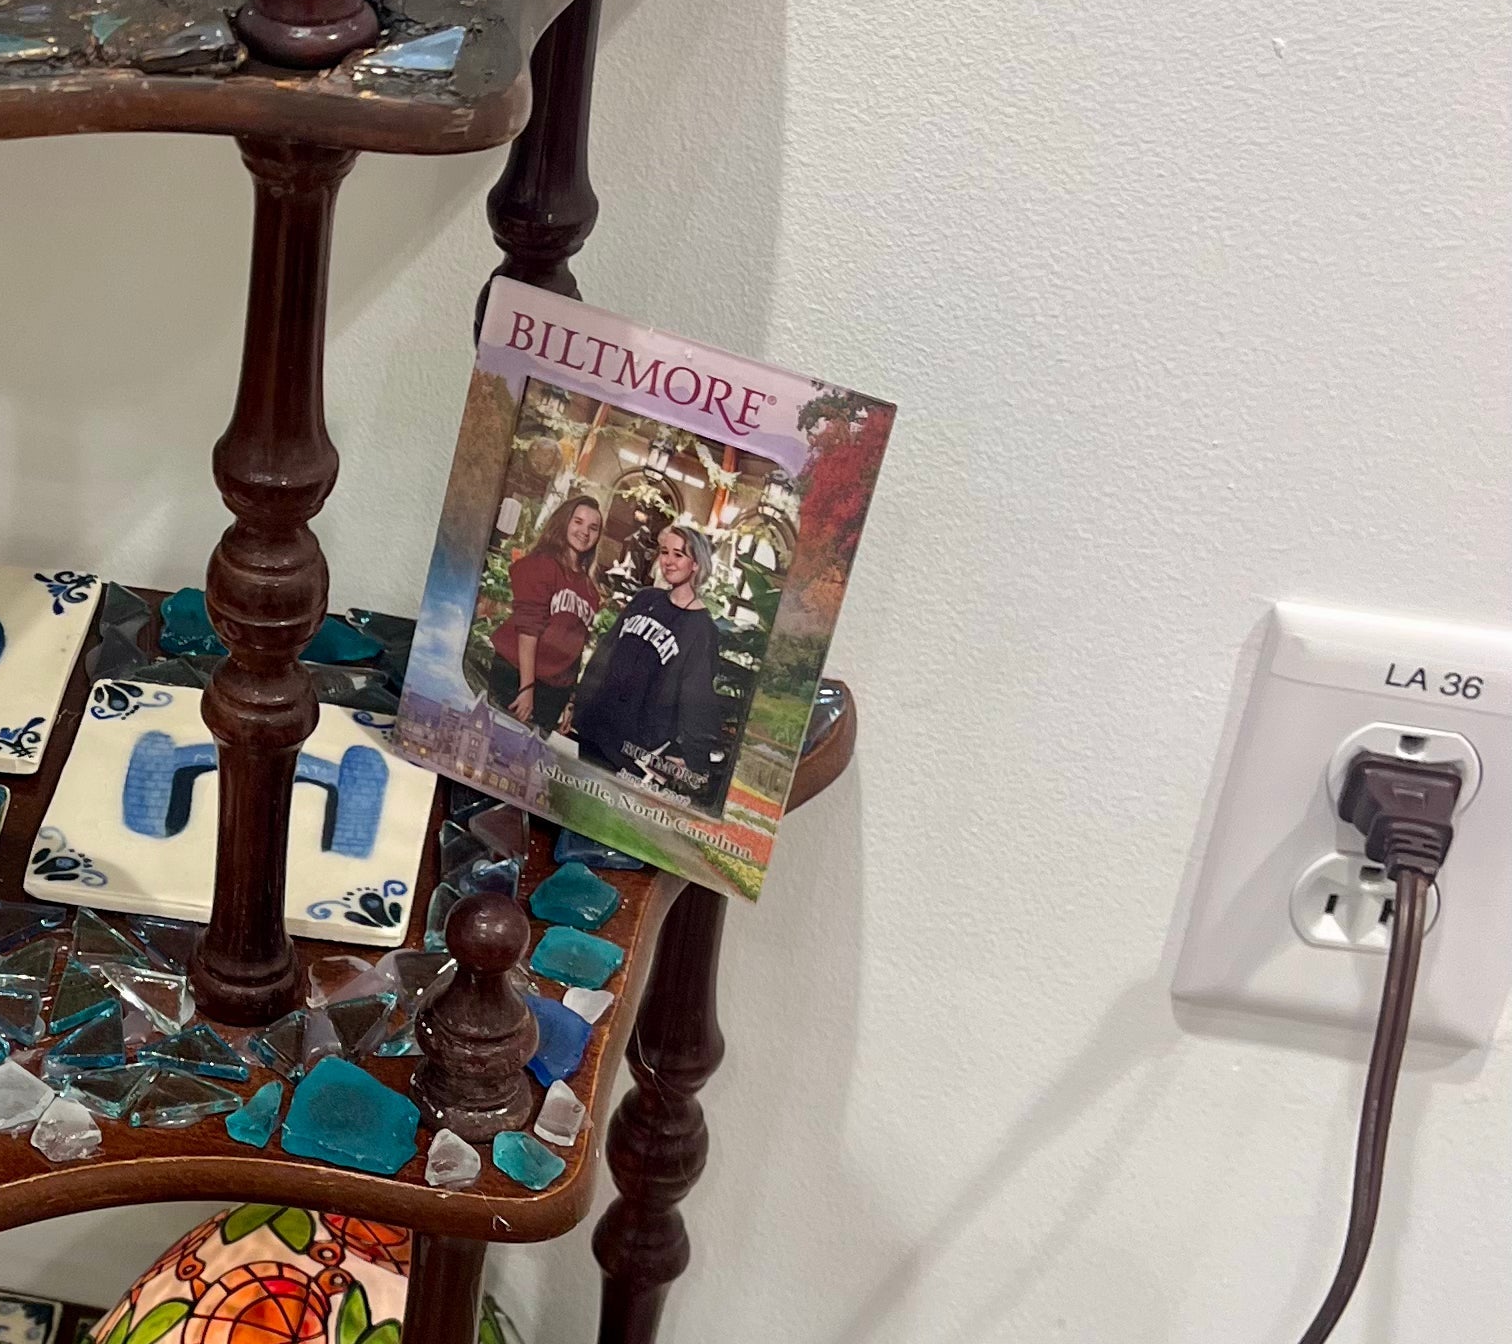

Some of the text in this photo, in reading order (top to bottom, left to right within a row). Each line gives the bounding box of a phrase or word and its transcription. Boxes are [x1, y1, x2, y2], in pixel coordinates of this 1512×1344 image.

[1385, 663, 1485, 700] LA 36
[536, 760, 753, 859] Asheville, North Carolina
